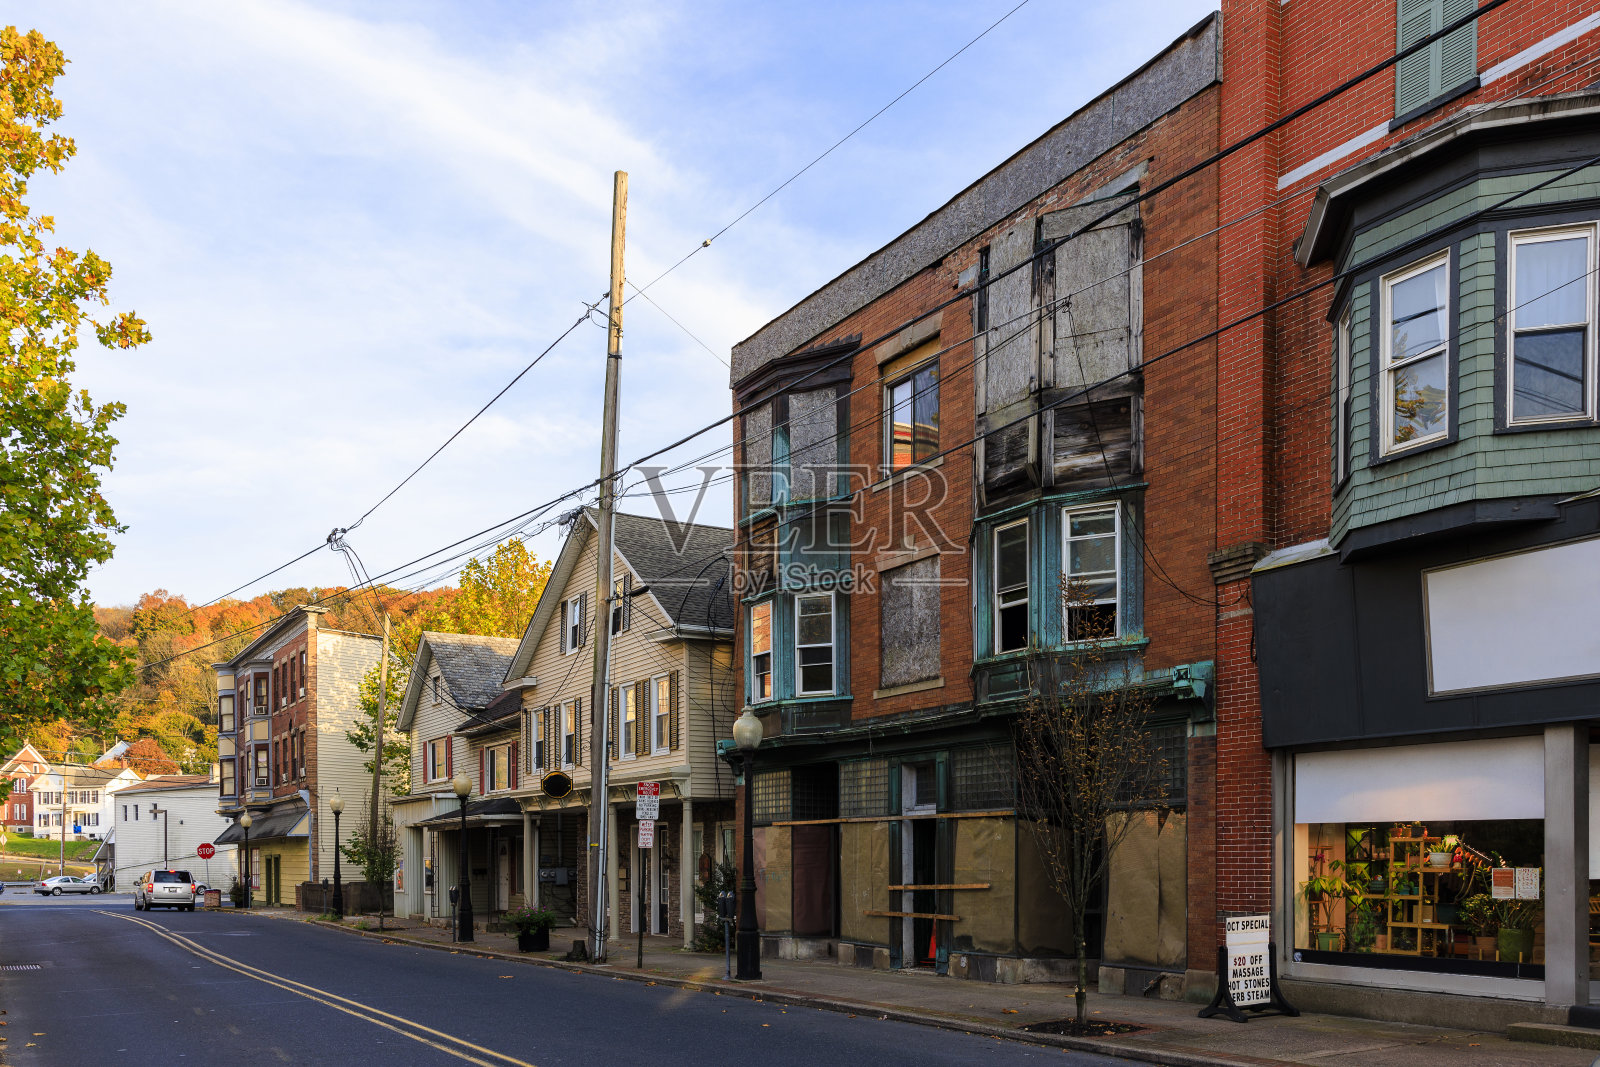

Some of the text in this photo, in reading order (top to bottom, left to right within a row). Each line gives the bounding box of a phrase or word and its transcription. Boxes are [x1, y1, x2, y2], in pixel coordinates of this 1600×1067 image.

[1227, 920, 1268, 931] OCT SPECIAL
[1233, 955, 1262, 966] $20 OFF
[1232, 967, 1263, 978] MASSAGE
[1244, 978, 1270, 989] STONES
[1232, 990, 1270, 1002] ERB STEAM
